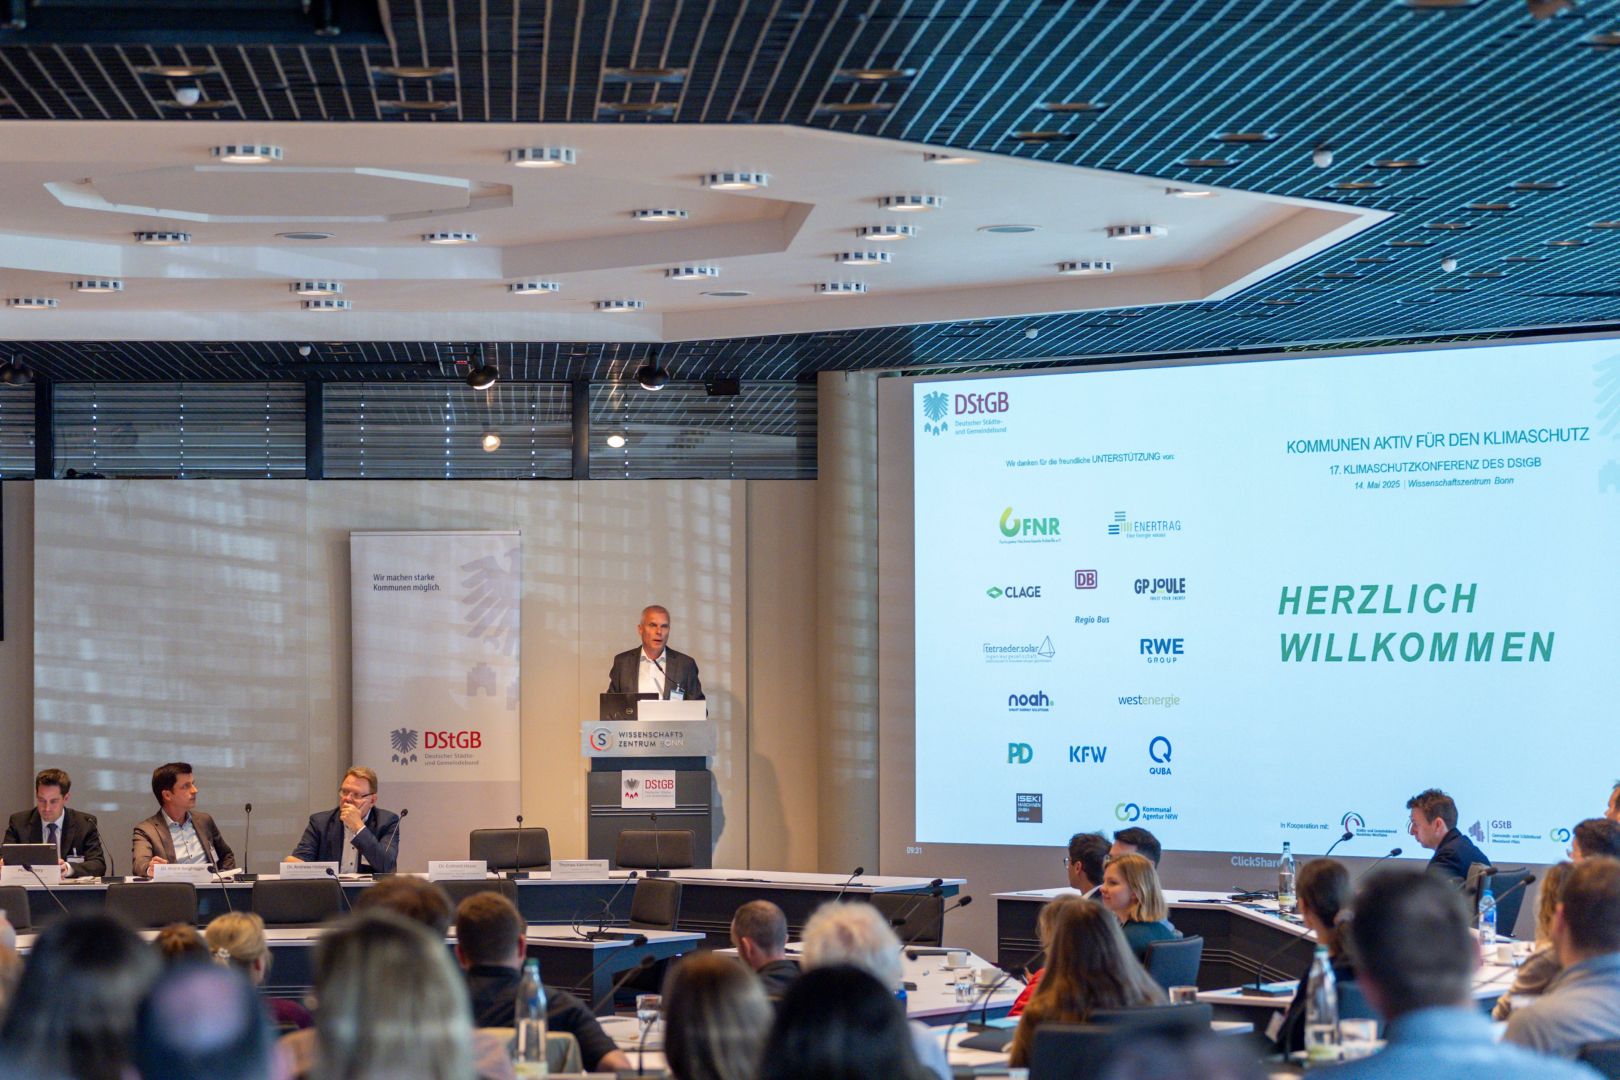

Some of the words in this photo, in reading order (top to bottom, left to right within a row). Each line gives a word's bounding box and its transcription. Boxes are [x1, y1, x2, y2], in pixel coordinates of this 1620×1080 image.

[954, 391, 1009, 415] DStGB
[1286, 436, 1370, 454] KOMMUNEN
[1373, 435, 1413, 451] AKTIV
[1416, 432, 1445, 448] FÜR
[1449, 432, 1480, 447] DEN
[1483, 427, 1590, 445] KLIMASCHUTZ
[1005, 460, 1016, 468] Wir
[1016, 459, 1038, 468] danken
[1039, 458, 1048, 466] für
[1048, 458, 1058, 466] die
[1058, 456, 1091, 466] freundliche
[1092, 452, 1161, 464] UNTERSTÜTZUNG
[1162, 454, 1175, 462] von:
[1329, 465, 1341, 475] 17.
[1343, 459, 1479, 474] KLIMASCHUTZKONFERENZ
[1482, 458, 1504, 470] DES
[1507, 457, 1542, 468] DStGB
[1355, 481, 1365, 490] 14.
[1367, 480, 1381, 489] Mai
[1382, 480, 1400, 489] 2025
[1408, 477, 1491, 488] Wissenschaftszentrum
[1494, 476, 1514, 485] Bonn
[1022, 517, 1061, 536] FNR
[1134, 519, 1181, 532] ENERTRAG
[373, 573, 385, 581] Wir
[386, 573, 413, 581] machen
[413, 573, 435, 581] starke
[1077, 572, 1095, 586] DB
[373, 583, 411, 592] Kommunen
[412, 583, 441, 593] möglich.
[1005, 586, 1041, 598] CLAGE
[1134, 578, 1149, 594] GP
[1278, 583, 1477, 615] HERZLICH
[1075, 616, 1095, 625] Regio
[1097, 616, 1110, 624] Bus
[985, 643, 1039, 654] tetraeder.solar
[1140, 638, 1184, 655] RWE
[1280, 631, 1555, 662] WILLKOMMEN
[1118, 695, 1180, 708] westenergie
[424, 731, 482, 749] DStGB
[598, 733, 607, 746] S
[618, 731, 684, 739] WISSENSCHAFTS
[1008, 742, 1033, 764] PD
[1149, 767, 1172, 776] QUBA
[645, 779, 674, 790] DStGB
[1017, 795, 1041, 803] ISEKI
[1286, 822, 1319, 831] Kooperation
[1492, 820, 1512, 829] GStB
